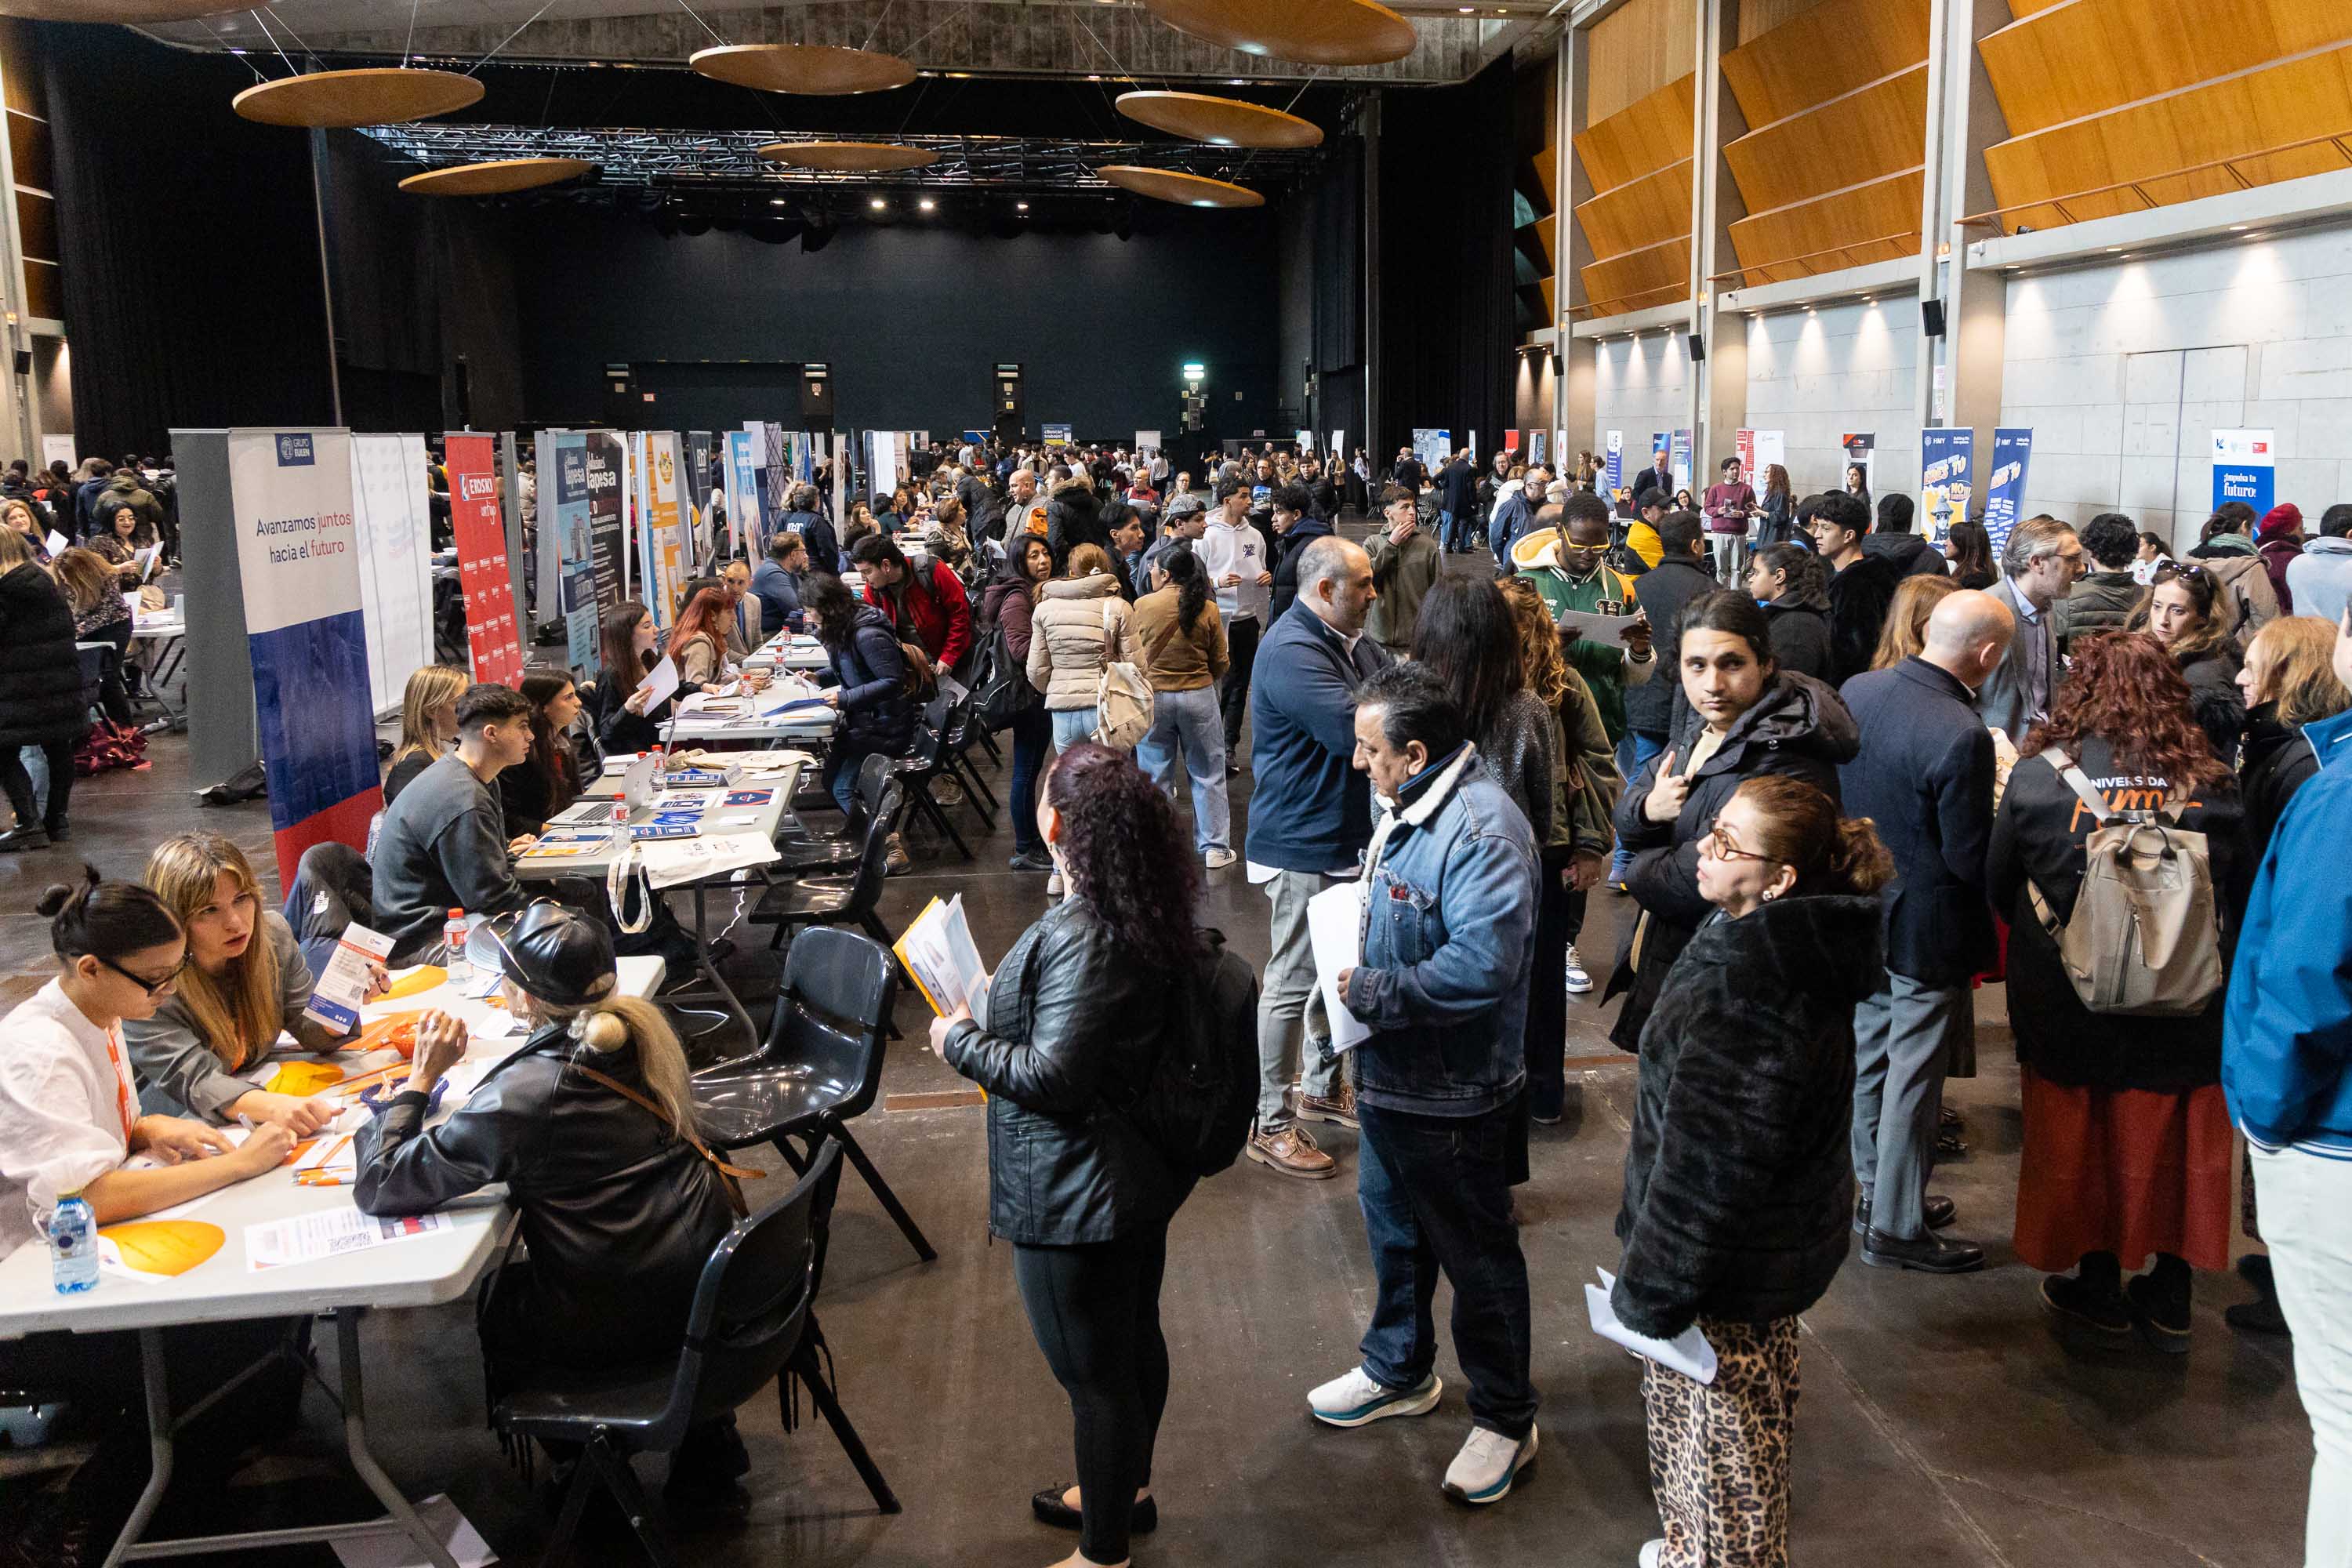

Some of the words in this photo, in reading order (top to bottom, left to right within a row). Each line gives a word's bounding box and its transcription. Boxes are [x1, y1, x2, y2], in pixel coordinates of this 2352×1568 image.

[293, 438, 309, 447] GRUPO
[294, 448, 310, 457] EULEN
[2249, 474, 2257, 483] tu
[2223, 482, 2256, 498] futuro!
[256, 517, 317, 537] Avanzamos
[317, 510, 352, 535] juntos
[269, 543, 298, 564] hacia
[299, 540, 310, 559] el
[310, 539, 345, 557] futuro
